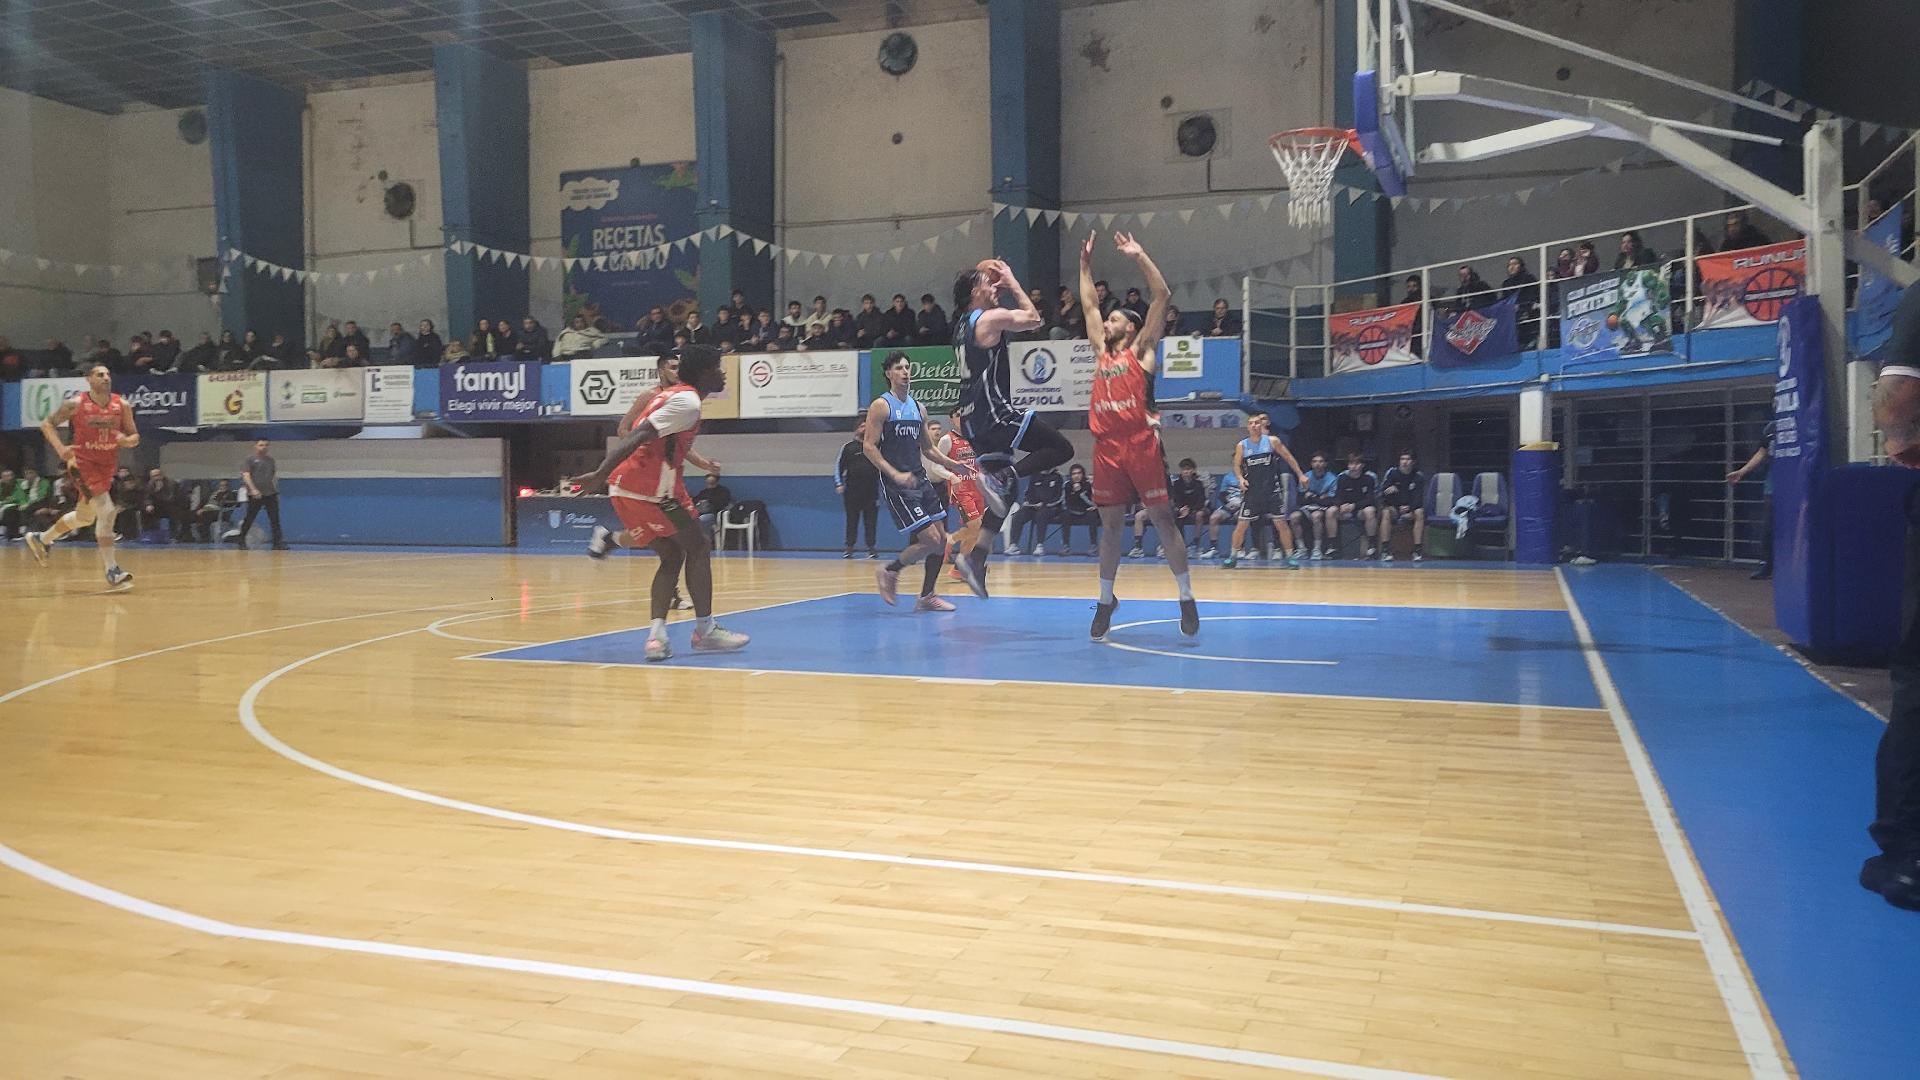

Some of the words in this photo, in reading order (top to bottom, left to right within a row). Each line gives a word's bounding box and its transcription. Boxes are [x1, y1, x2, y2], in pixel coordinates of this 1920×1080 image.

[593, 224, 665, 249] RECETAS
[454, 363, 526, 400] famyl
[478, 398, 501, 411] vivir
[503, 398, 538, 415] mejor
[1012, 394, 1065, 406] ZAPIOLA
